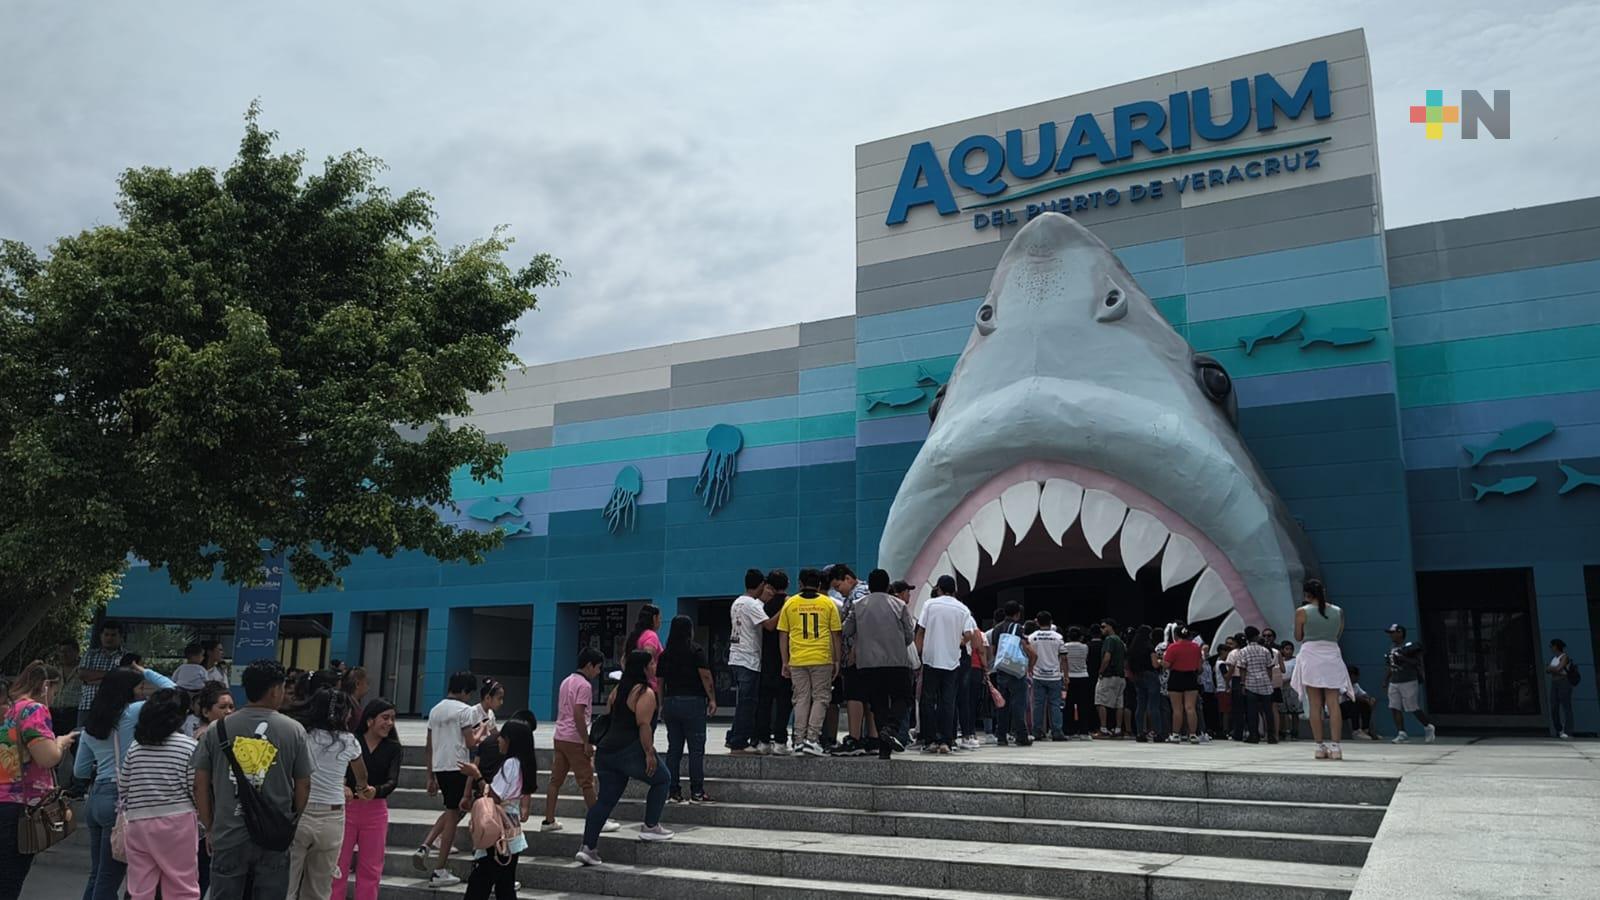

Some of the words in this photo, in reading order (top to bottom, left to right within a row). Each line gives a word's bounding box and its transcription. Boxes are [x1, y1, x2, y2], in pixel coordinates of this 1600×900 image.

[885, 59, 1332, 227] AQUARIUM
[974, 208, 1018, 230] DEL
[1129, 180, 1164, 202] DE
[1172, 148, 1321, 195] VERACRUZ
[799, 612, 820, 640] 11
